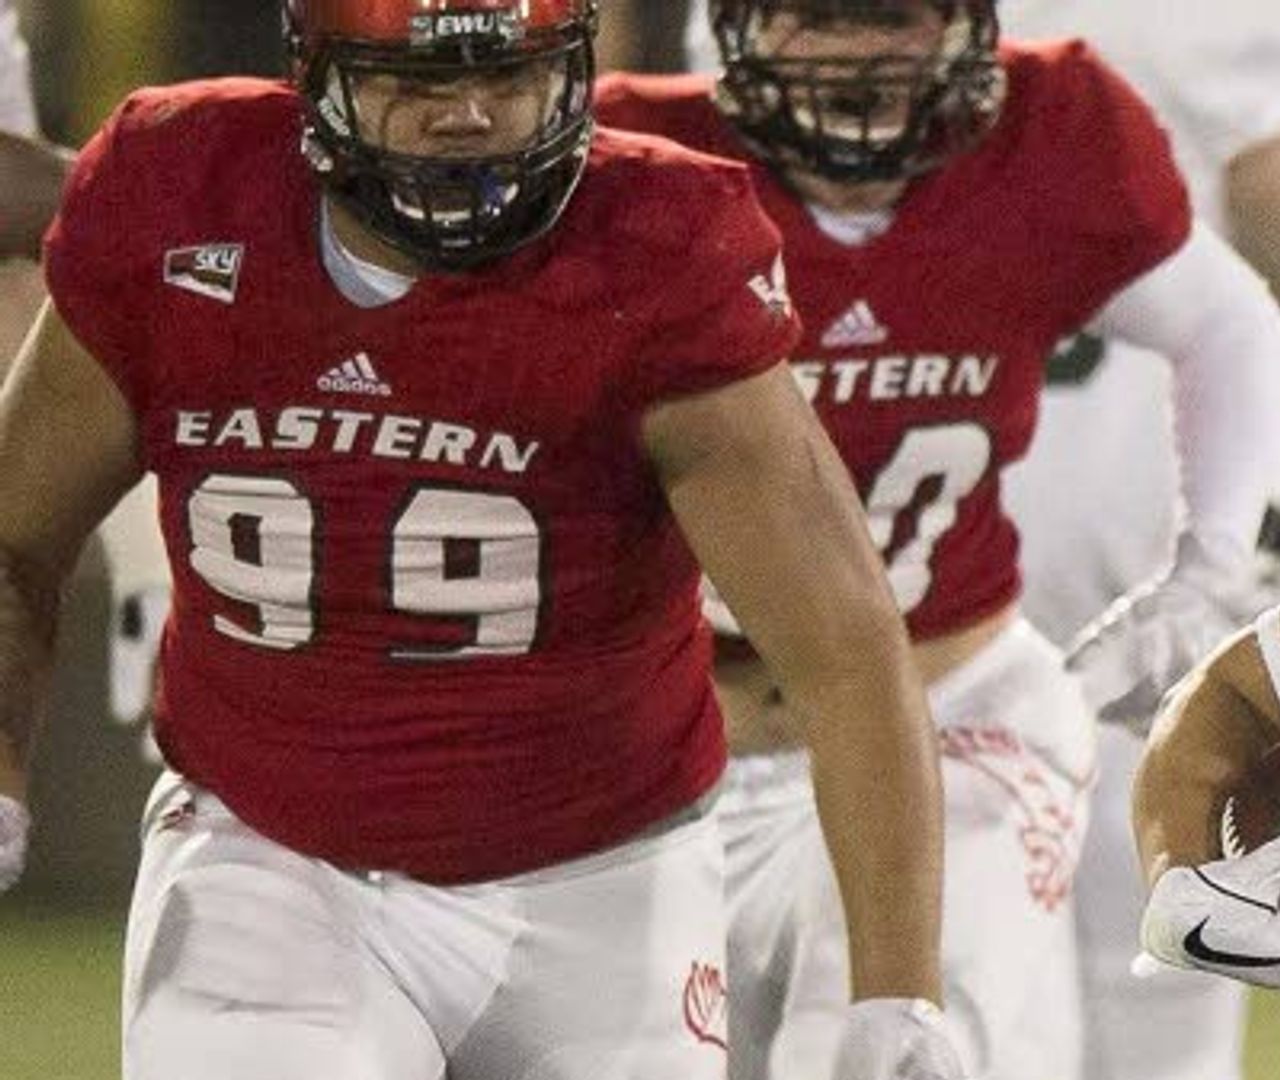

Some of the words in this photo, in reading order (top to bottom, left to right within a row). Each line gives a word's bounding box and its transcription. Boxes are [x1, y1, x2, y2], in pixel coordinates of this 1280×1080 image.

[435, 12, 494, 36] EWU
[194, 249, 236, 274] SKY
[316, 375, 393, 397] adidas
[790, 354, 998, 402] STERN
[176, 404, 540, 473] EASTERN
[188, 473, 541, 660] 99
